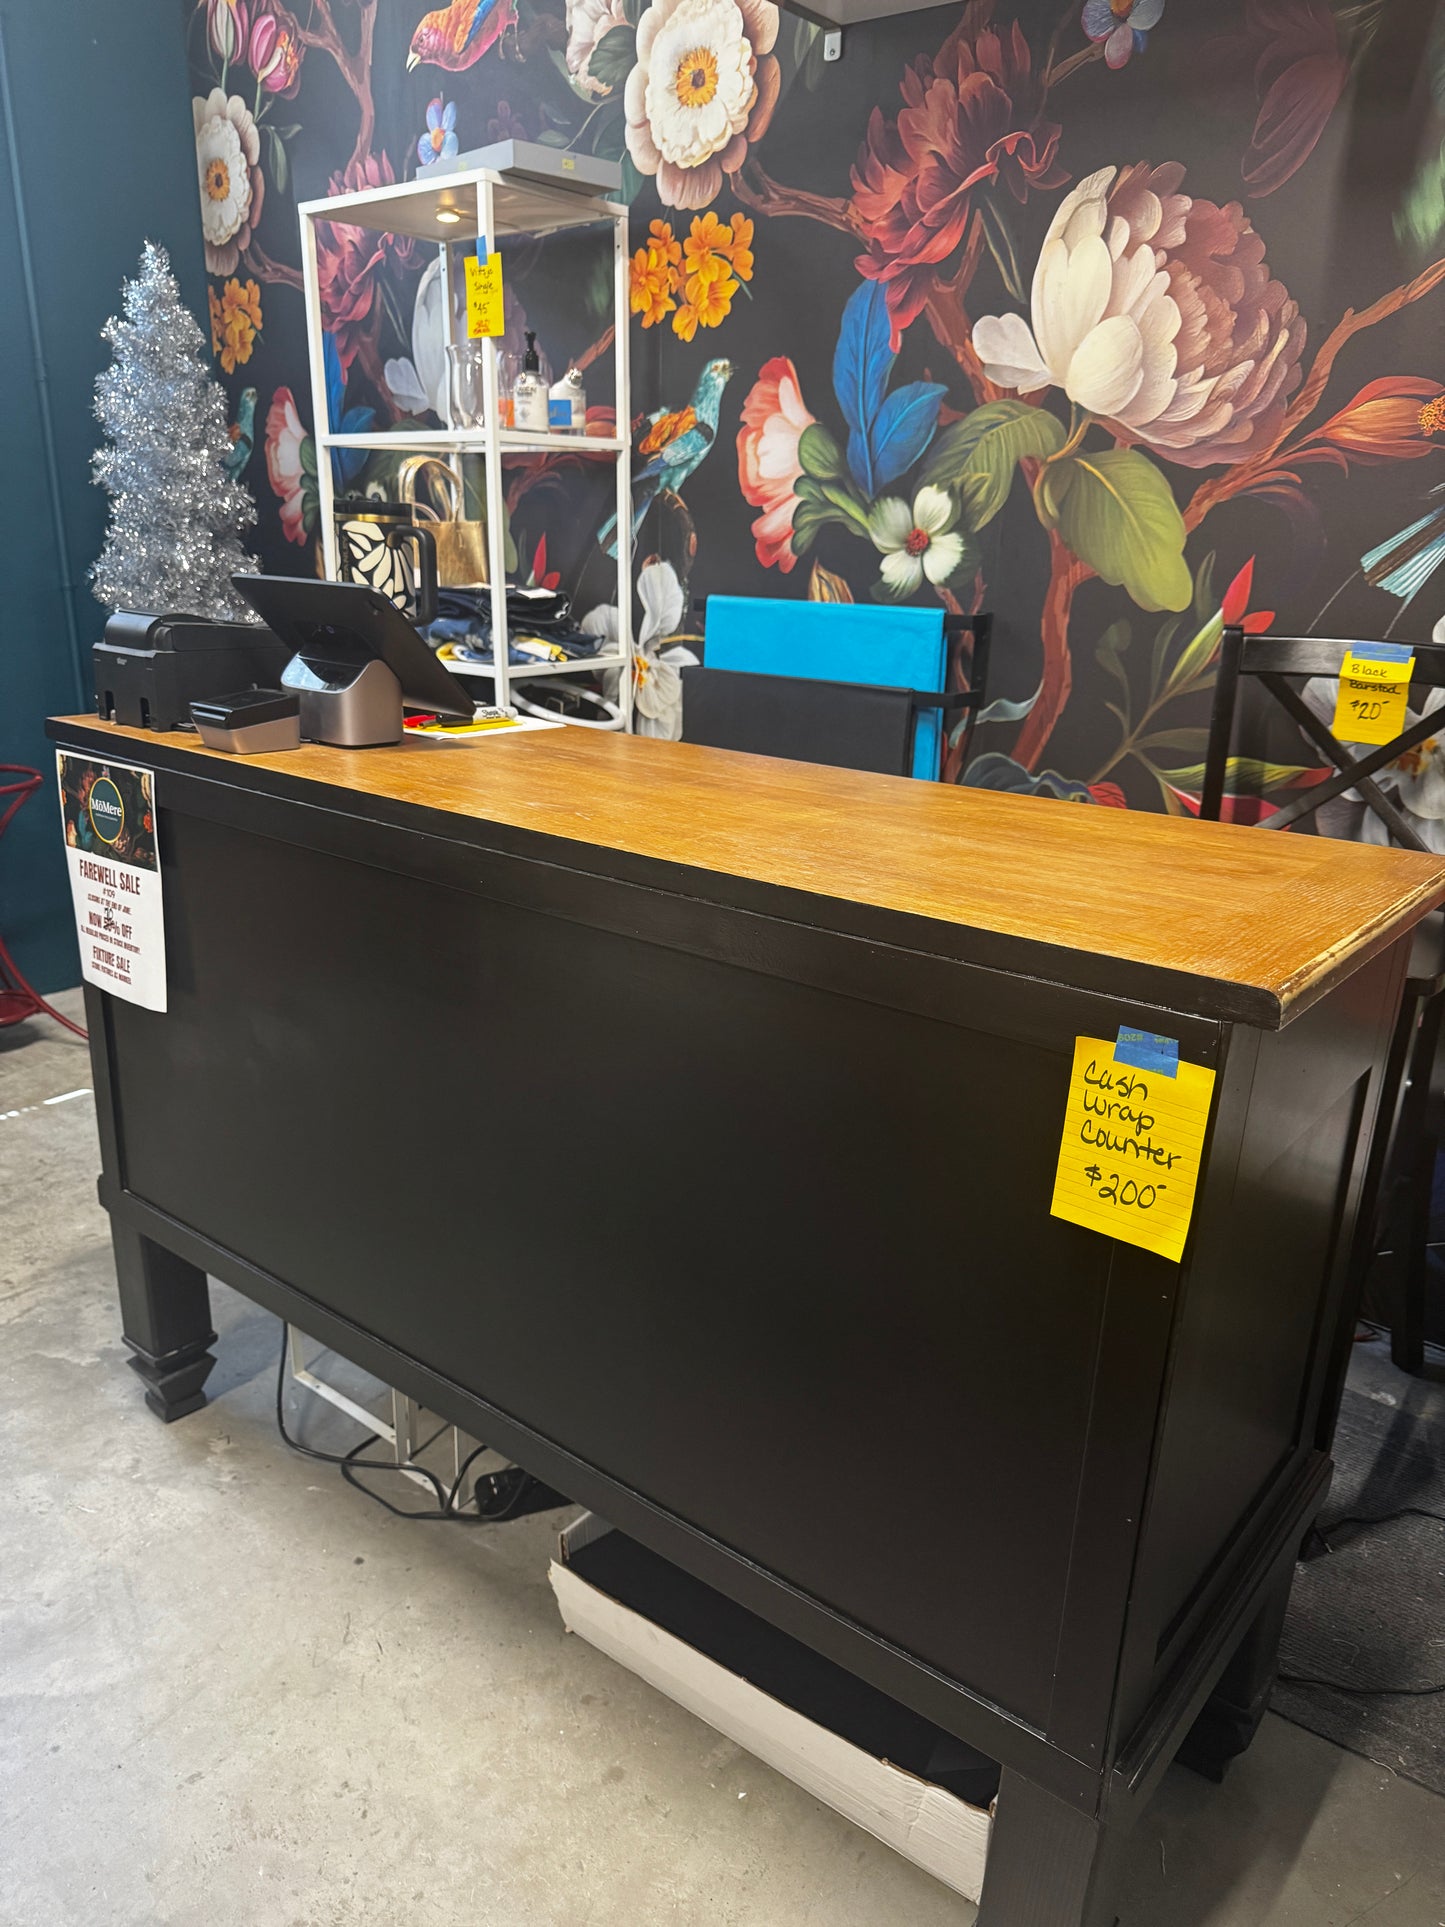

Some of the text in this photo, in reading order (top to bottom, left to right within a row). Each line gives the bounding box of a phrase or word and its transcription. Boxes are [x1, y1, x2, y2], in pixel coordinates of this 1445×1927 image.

[1351, 663, 1388, 678] Black
[79, 858, 141, 895] FAREWELL SALE
[88, 911, 102, 929] NOW
[121, 923, 132, 940] OFF
[92, 945, 131, 973] FIXTURE SALE
[1083, 1060, 1149, 1101] Cash
[1080, 1119, 1182, 1170] Counter
